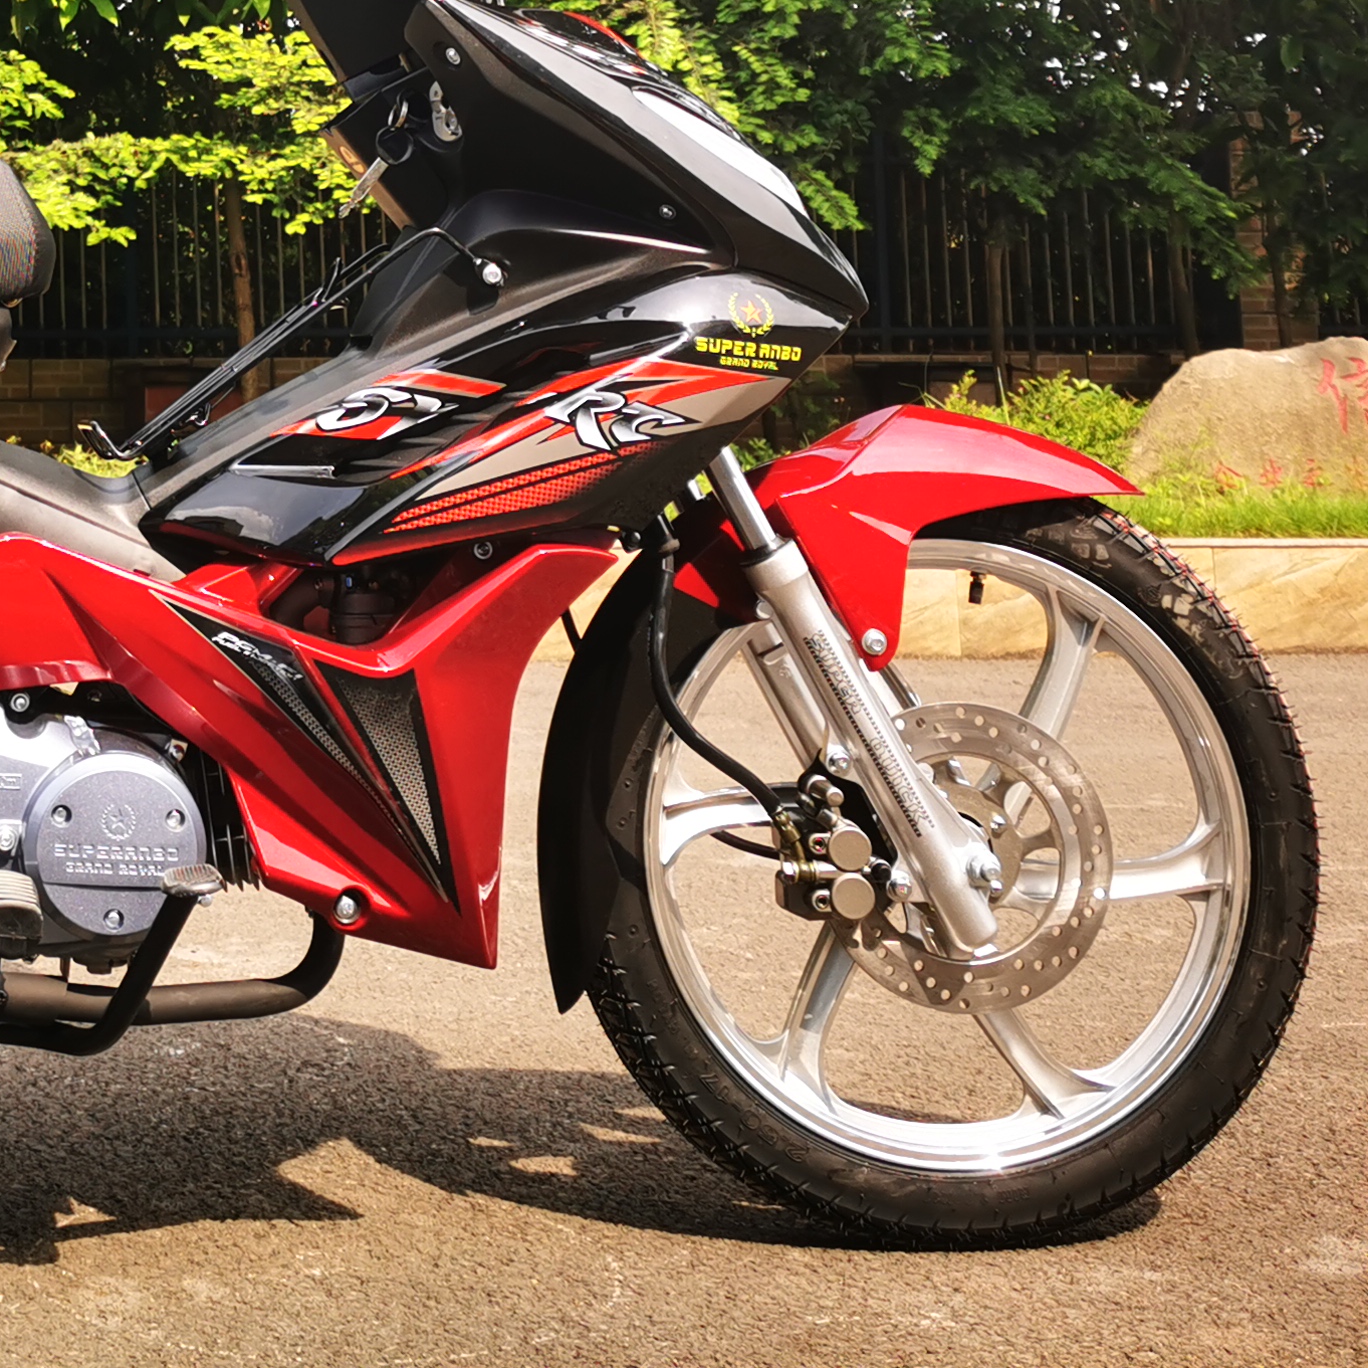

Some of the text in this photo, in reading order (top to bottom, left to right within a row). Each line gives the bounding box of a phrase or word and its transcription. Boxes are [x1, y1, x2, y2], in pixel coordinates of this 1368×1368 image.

[694, 336, 756, 357] SUPER
[719, 356, 750, 368] GRAND
[64, 861, 167, 877] GRAND ROYAL
[698, 1072, 810, 1163] 2.50-17
